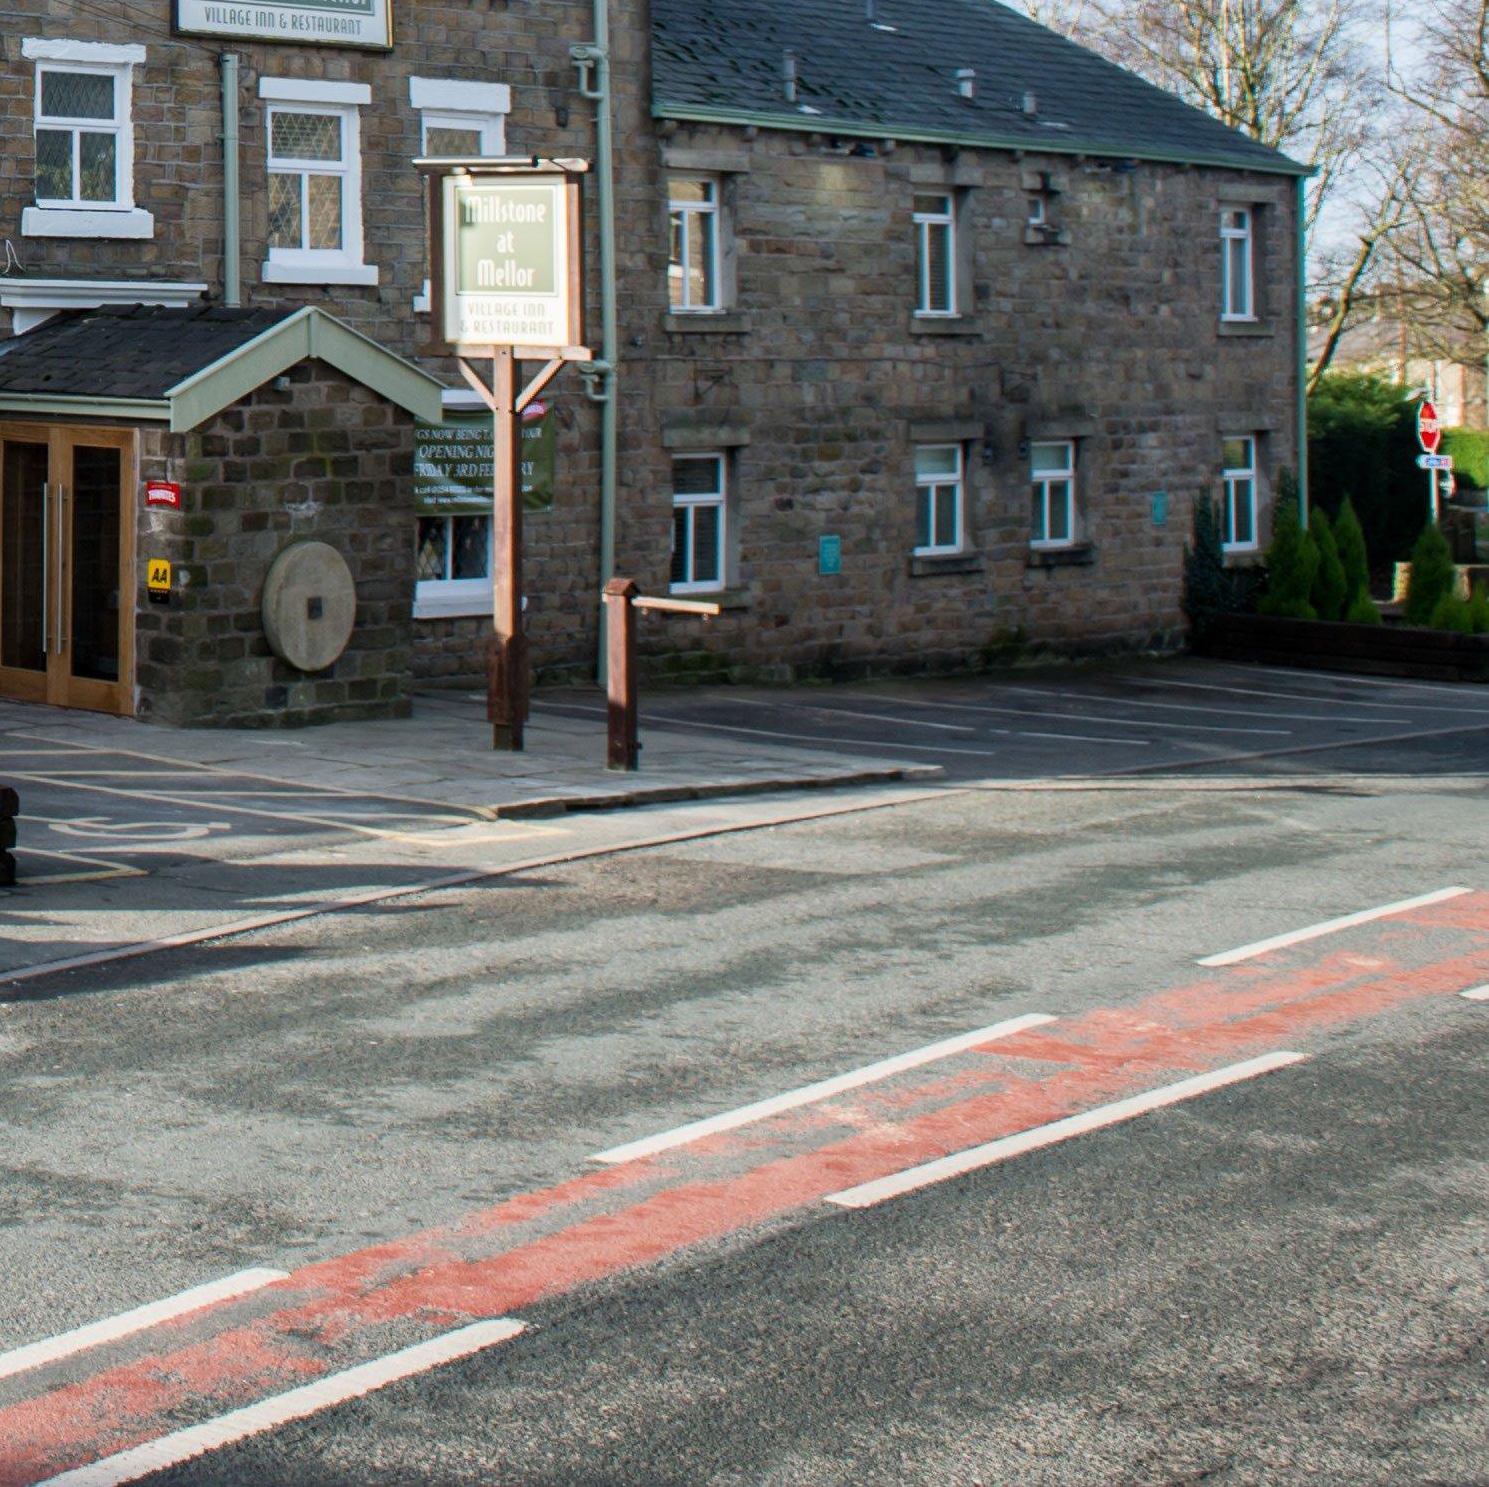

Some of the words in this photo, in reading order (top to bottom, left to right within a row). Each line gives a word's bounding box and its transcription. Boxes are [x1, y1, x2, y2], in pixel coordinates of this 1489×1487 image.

[204, 6, 251, 26] VILLAGE
[255, 11, 276, 29] INN
[279, 13, 287, 29] &
[291, 14, 361, 35] RESTAURANT
[465, 195, 546, 223] Millstone
[496, 231, 515, 253] at
[477, 259, 535, 287] Mellor
[468, 302, 518, 315] VILLAGE
[523, 302, 546, 315] INN
[474, 321, 555, 334] RESTAURANT
[419, 444, 473, 458] OPENING
[152, 568, 167, 584] AA
